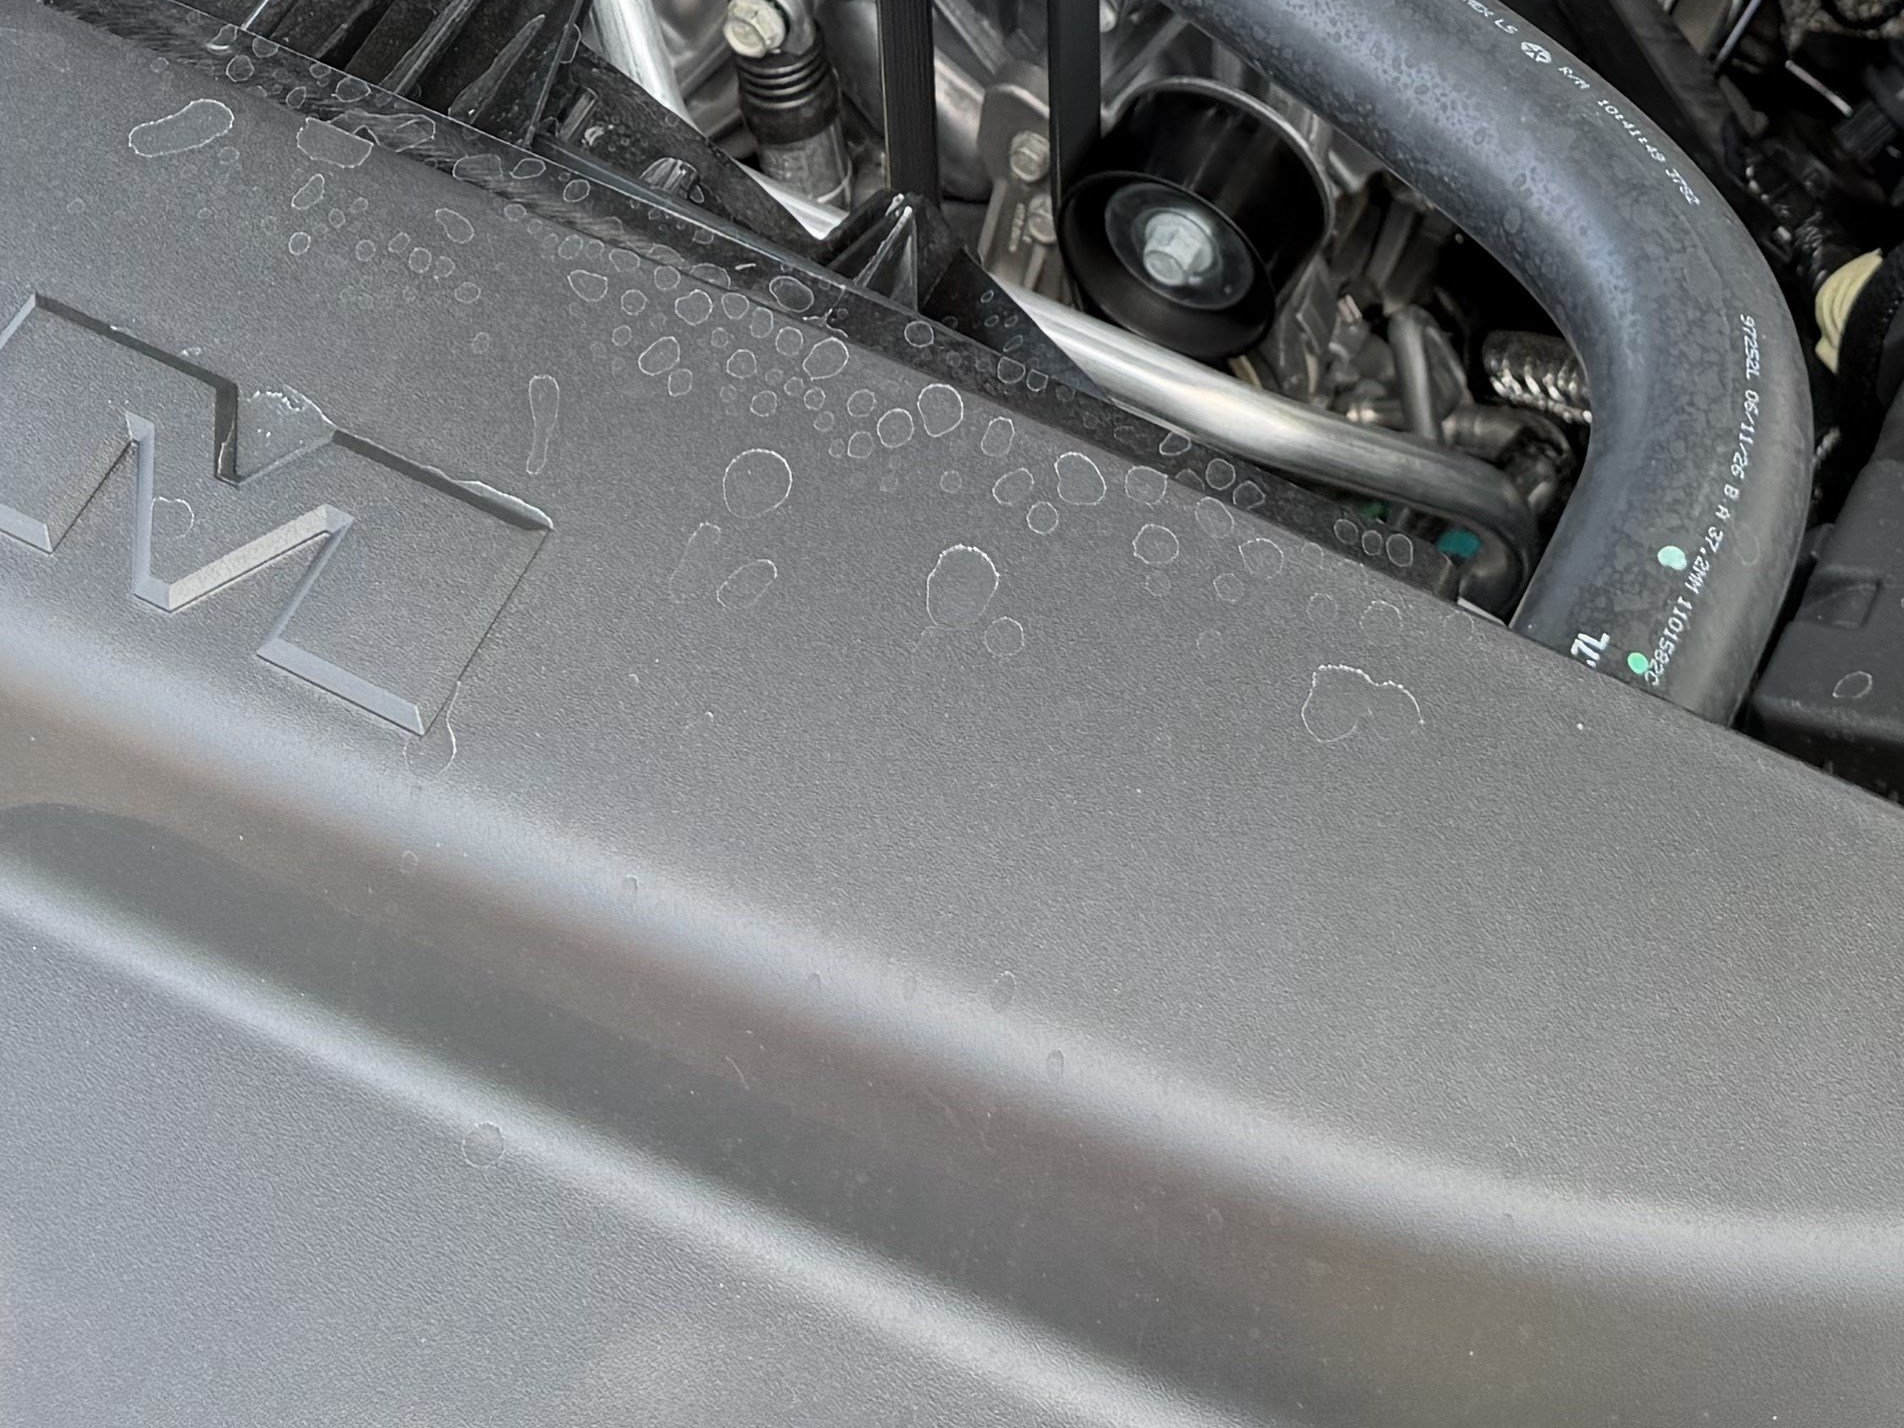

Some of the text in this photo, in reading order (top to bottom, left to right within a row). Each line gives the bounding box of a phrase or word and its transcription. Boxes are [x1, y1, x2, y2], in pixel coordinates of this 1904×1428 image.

[1644, 314, 1760, 686] 97252L 06/11/26 B A 37.2MM 1101582C
